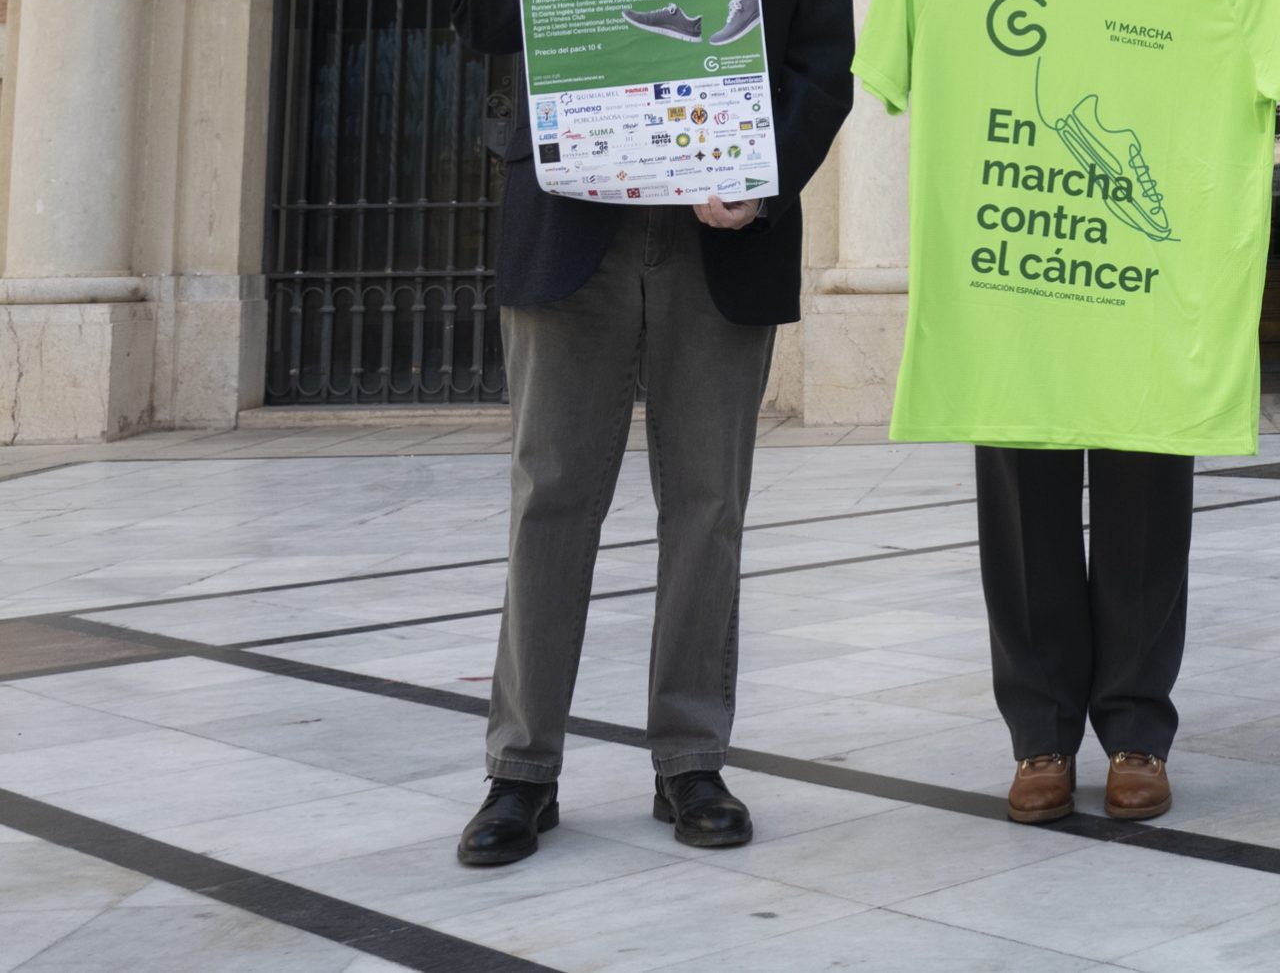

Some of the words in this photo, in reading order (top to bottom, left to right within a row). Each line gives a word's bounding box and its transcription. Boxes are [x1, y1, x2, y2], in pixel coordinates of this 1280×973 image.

[1104, 19, 1116, 31] VI
[1119, 23, 1173, 41] MARCHA
[570, 45, 586, 54] pack
[1121, 37, 1164, 50] CASTELLÓN
[564, 105, 602, 116] younexa
[589, 129, 615, 137] SUMA
[986, 107, 1036, 147] En
[982, 158, 1134, 203] marcha
[976, 203, 1109, 245] contra
[970, 241, 1010, 277] el
[1020, 247, 1160, 293] cáncer
[970, 281, 1015, 292] ASOCIACIÓN
[1016, 285, 1053, 297] ESPAÑOLA
[1055, 291, 1085, 301] CONTRA
[1086, 295, 1096, 303] EL
[1096, 296, 1126, 306] CÁNCER
